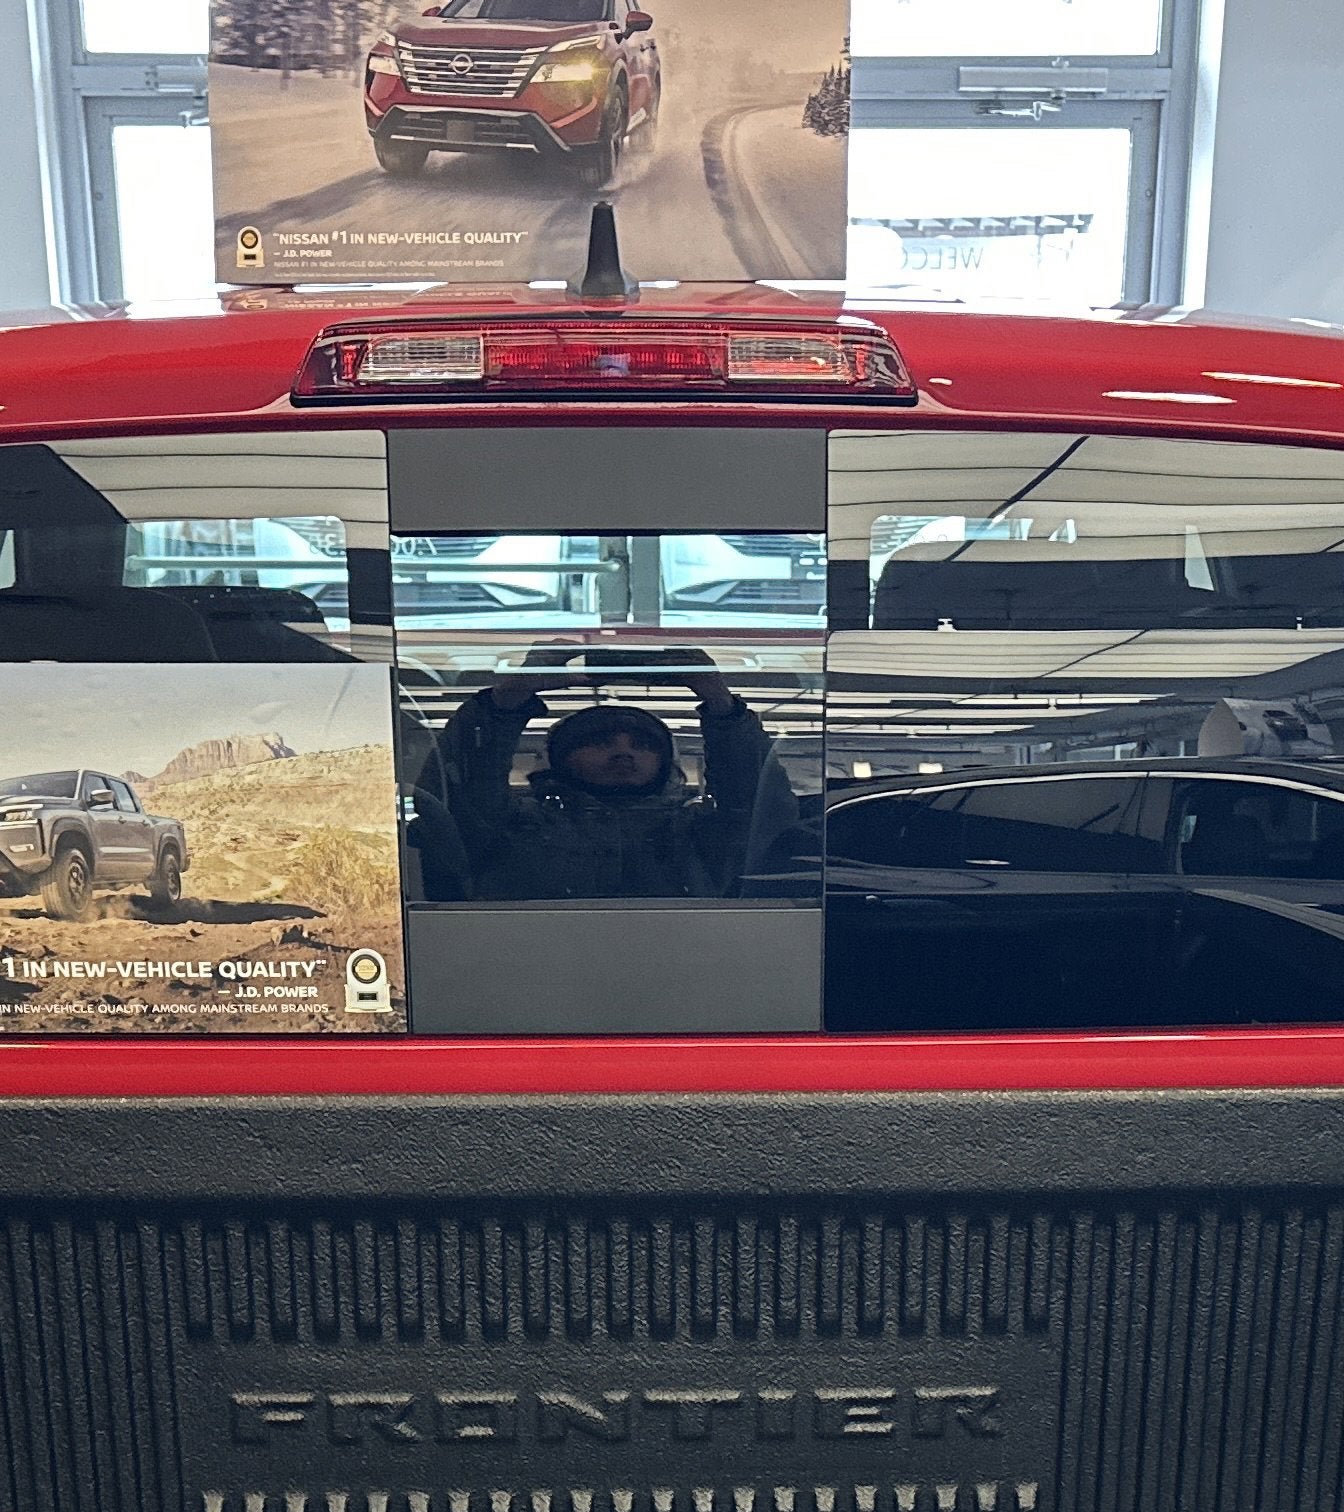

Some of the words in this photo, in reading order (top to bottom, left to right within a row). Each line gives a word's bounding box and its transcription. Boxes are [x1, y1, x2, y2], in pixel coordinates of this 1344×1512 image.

[331, 230, 347, 245] #1
[350, 232, 364, 245] IN
[367, 232, 461, 245] NEW-VEHICLE
[282, 249, 299, 258] J.D.
[299, 249, 333, 258] POWER
[23, 961, 47, 978] IN
[54, 960, 212, 978] NEW-VEHICLE
[234, 986, 261, 998] J.D.
[264, 986, 319, 998] POWER
[14, 1003, 94, 1014] NEW-VEHICLE
[97, 1003, 148, 1014] QUALITY
[151, 1003, 197, 1014] AMONG
[200, 1003, 278, 1014] MAINSTREAM
[281, 1003, 329, 1014] BRANDS
[231, 1385, 1003, 1443] FRONTIER
